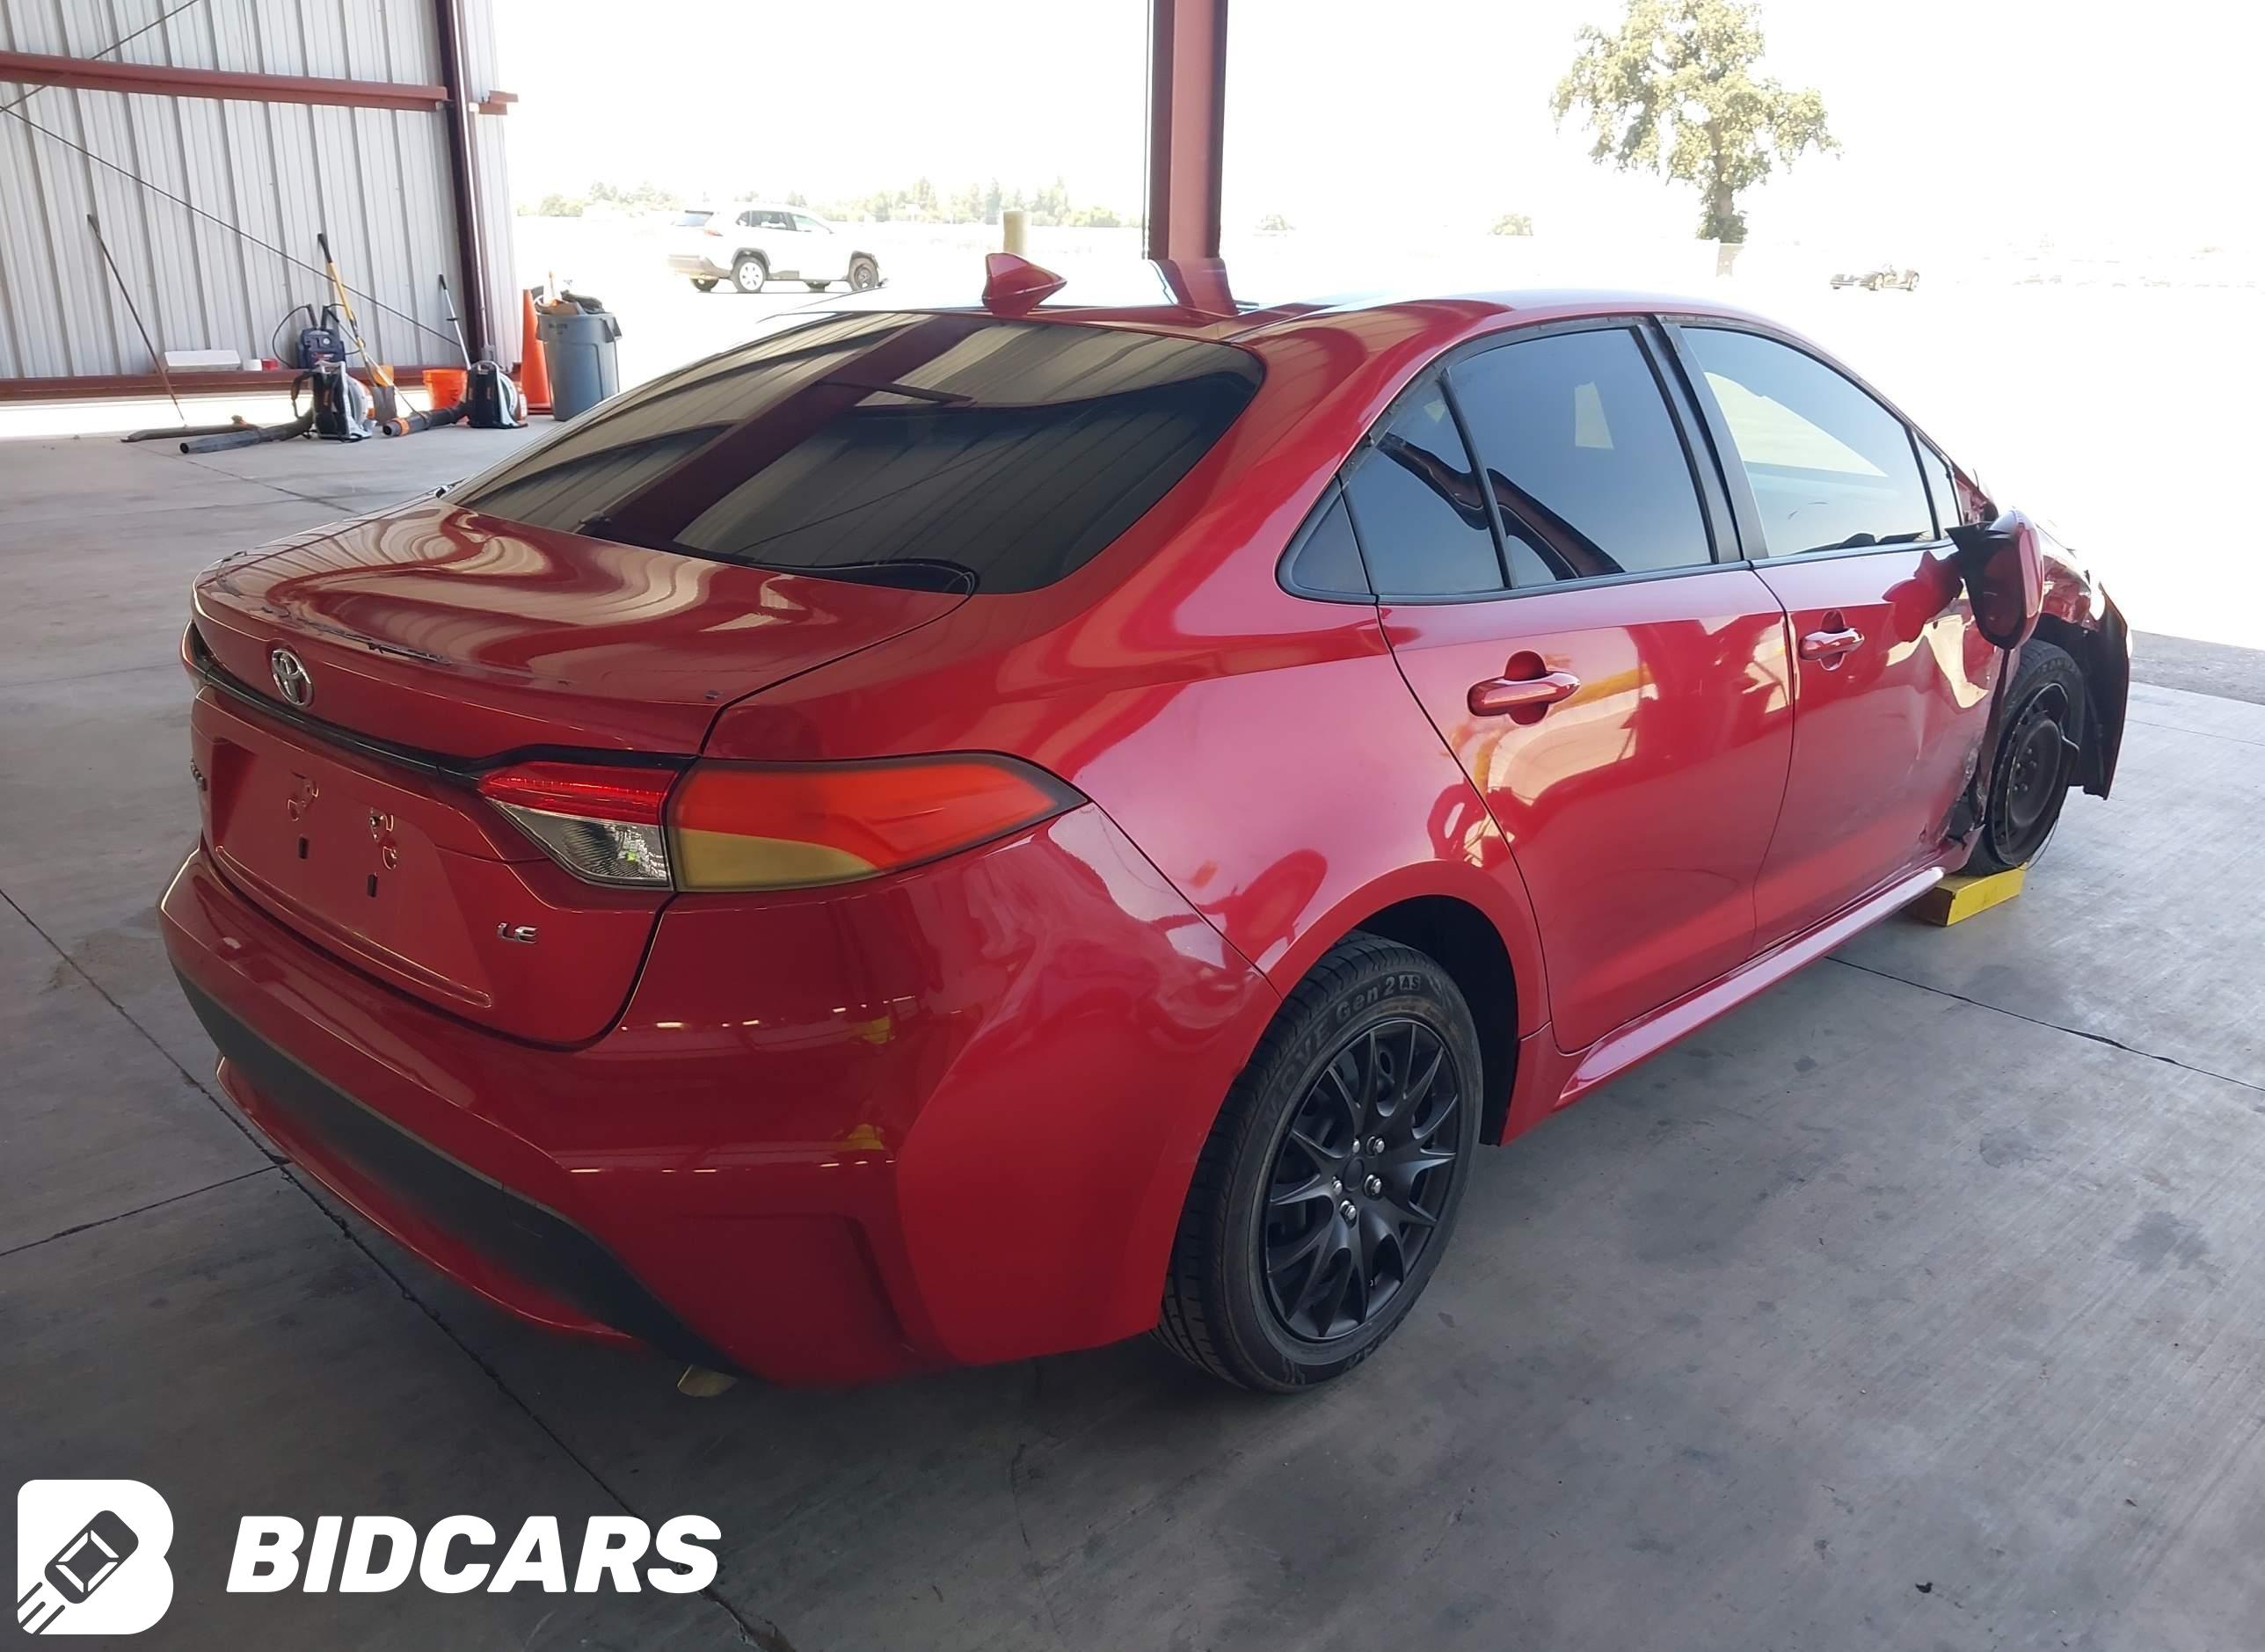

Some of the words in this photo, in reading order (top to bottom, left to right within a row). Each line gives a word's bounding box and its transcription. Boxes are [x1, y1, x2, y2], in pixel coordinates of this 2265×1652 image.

[497, 921, 538, 944] LE
[1336, 985, 1379, 1023] Gen
[1385, 976, 1395, 995] 2
[1399, 974, 1421, 992] AS
